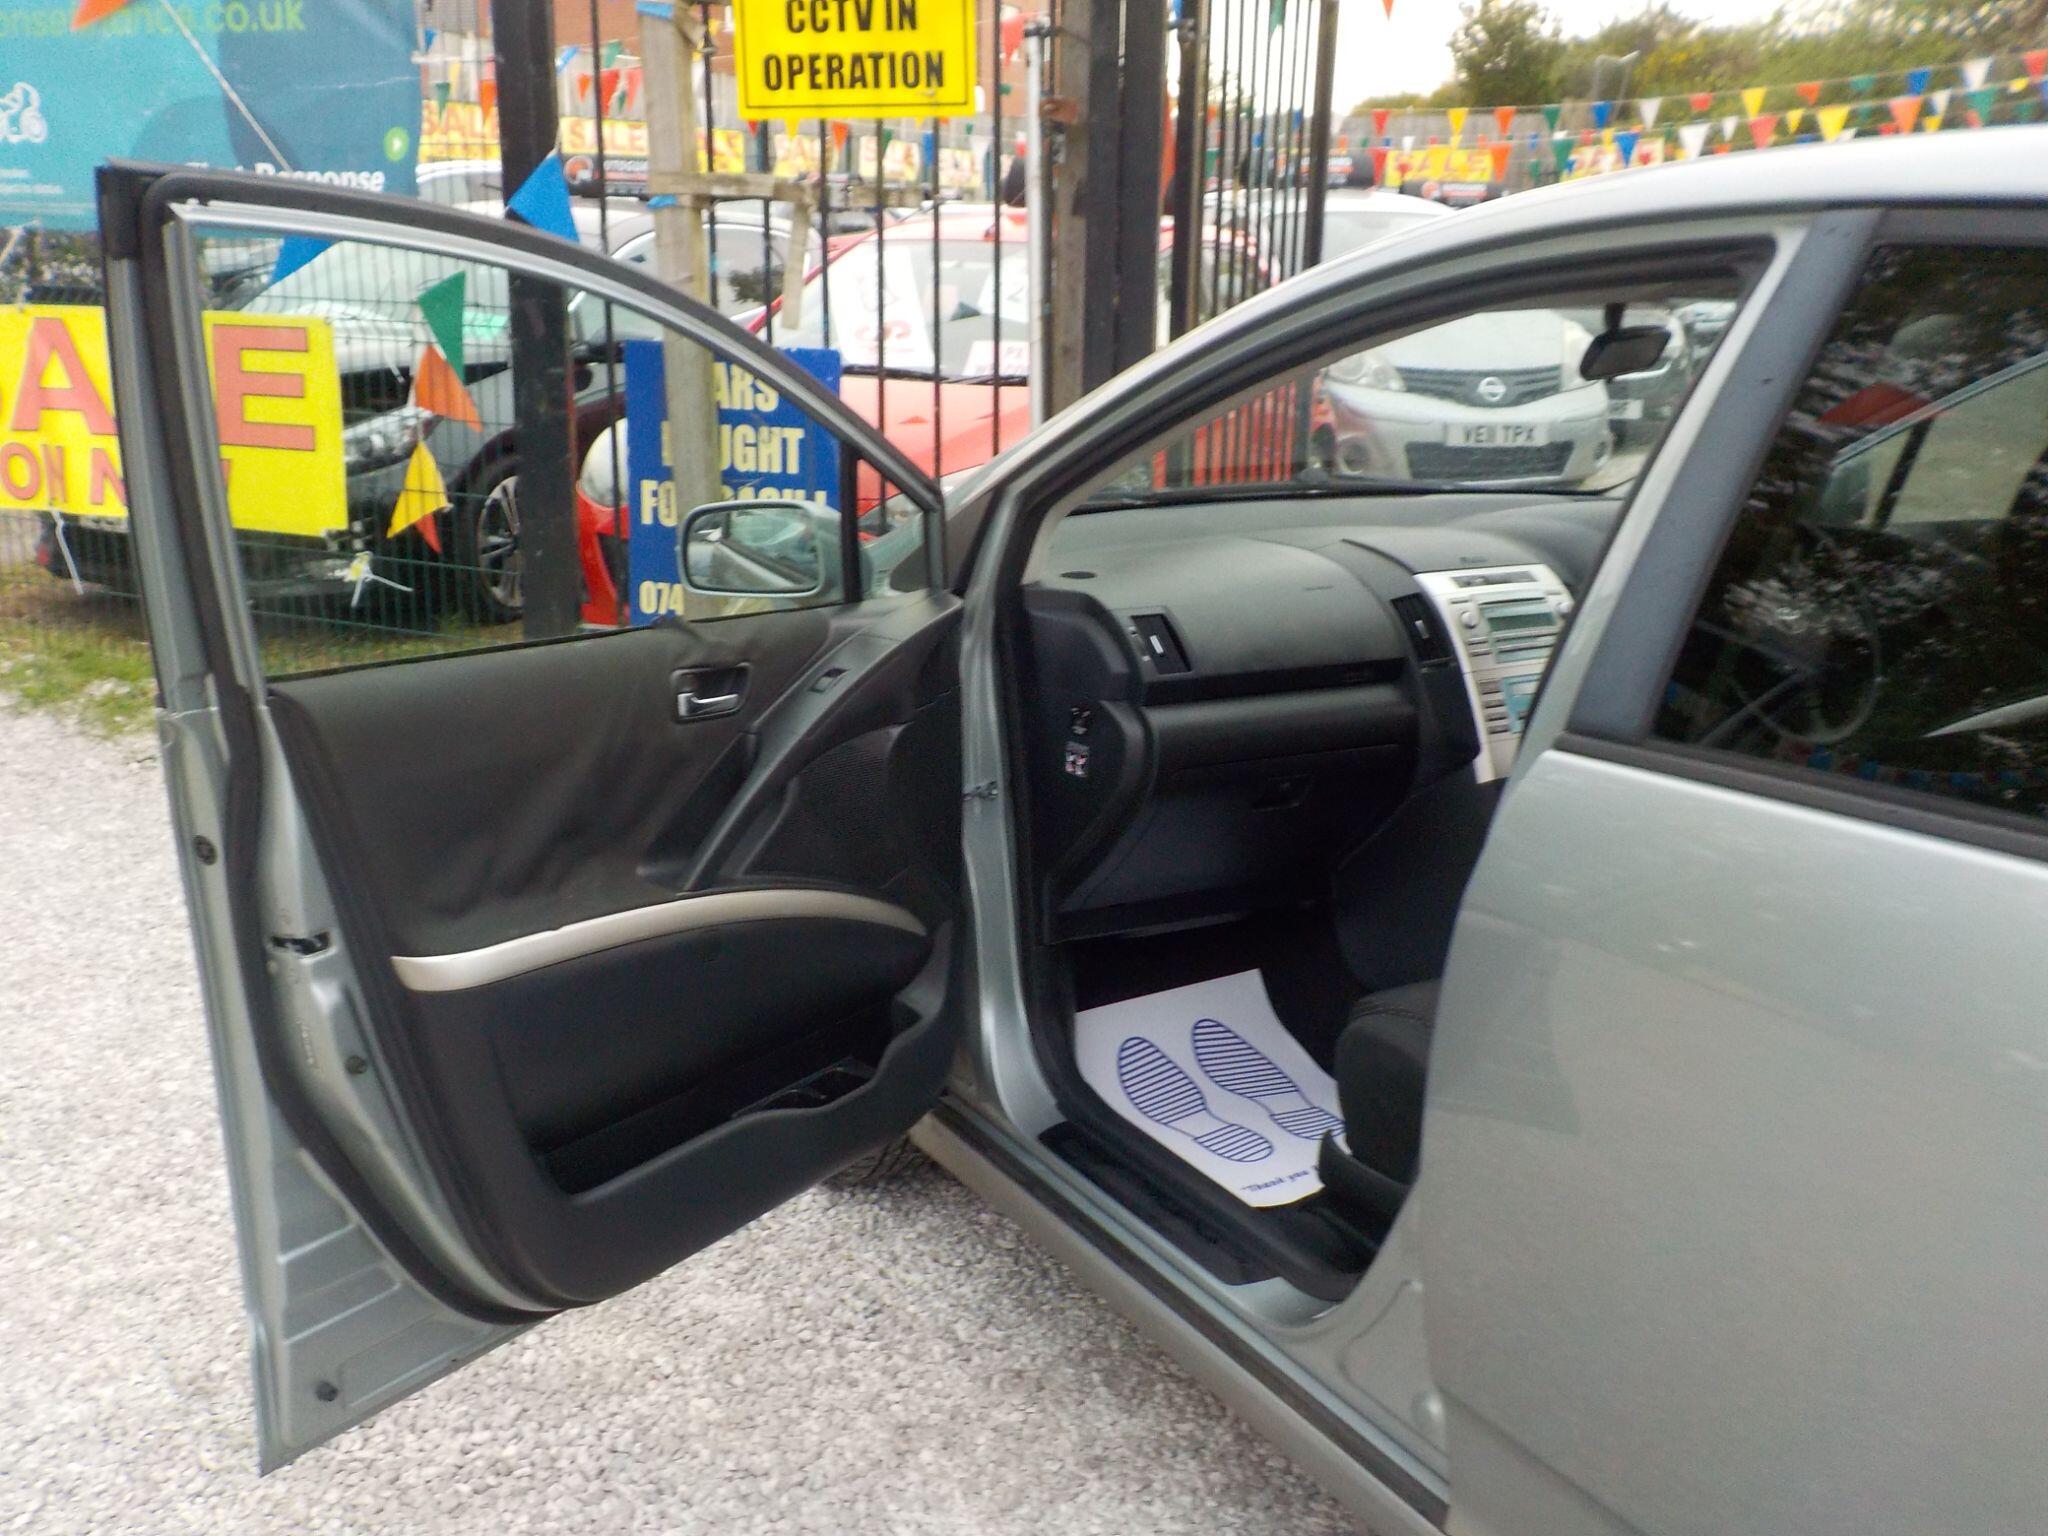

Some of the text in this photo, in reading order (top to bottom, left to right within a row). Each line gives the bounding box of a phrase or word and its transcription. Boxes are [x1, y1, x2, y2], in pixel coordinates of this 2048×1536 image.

[786, 0, 917, 33] CCTV IN
[763, 51, 944, 91] OPERATION
